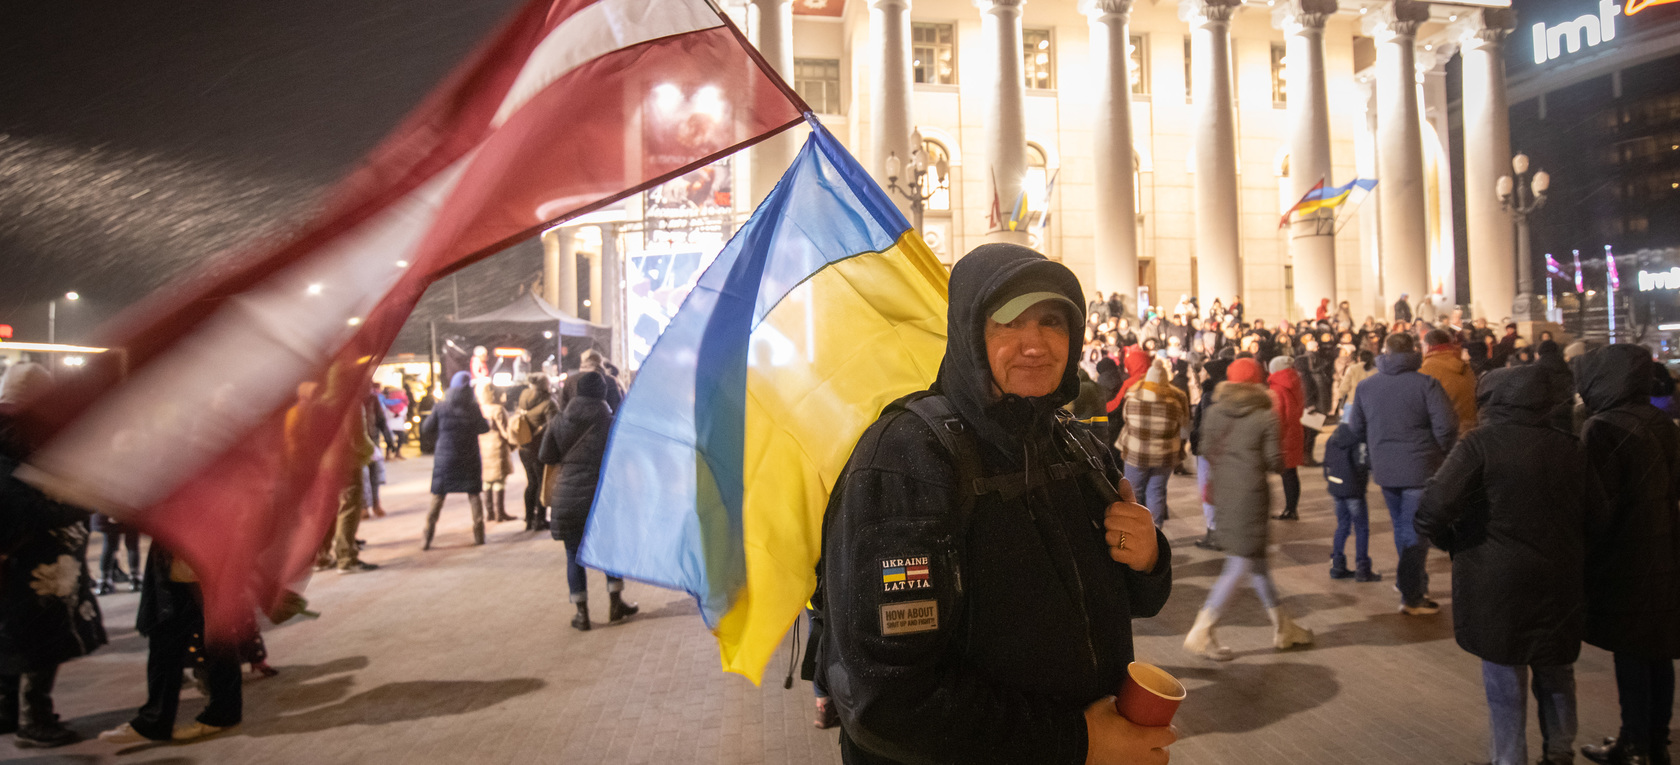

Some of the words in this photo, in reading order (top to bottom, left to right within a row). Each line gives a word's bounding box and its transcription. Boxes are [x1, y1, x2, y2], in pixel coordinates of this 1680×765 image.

[1532, 0, 1621, 64] lmt
[882, 557, 928, 568] UKRAINE
[884, 580, 930, 591] LATVIA
[886, 609, 905, 621] HOW
[907, 607, 934, 619] ABOUT
